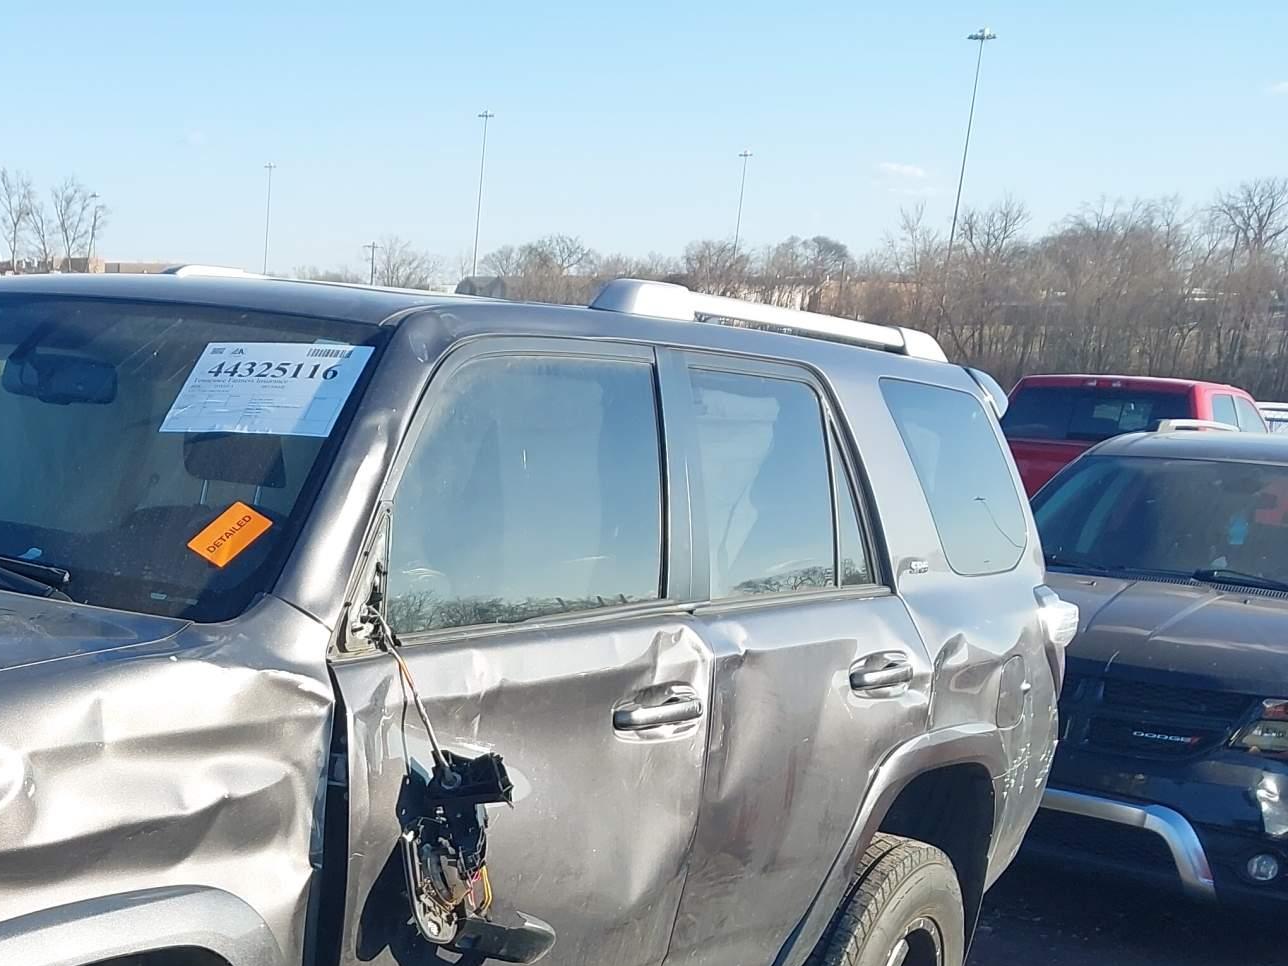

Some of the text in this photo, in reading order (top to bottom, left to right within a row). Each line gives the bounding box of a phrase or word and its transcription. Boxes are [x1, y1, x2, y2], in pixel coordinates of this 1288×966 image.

[208, 360, 340, 381] 44325116
[206, 515, 252, 554] DETAILED
[1133, 731, 1192, 743] DODGE
